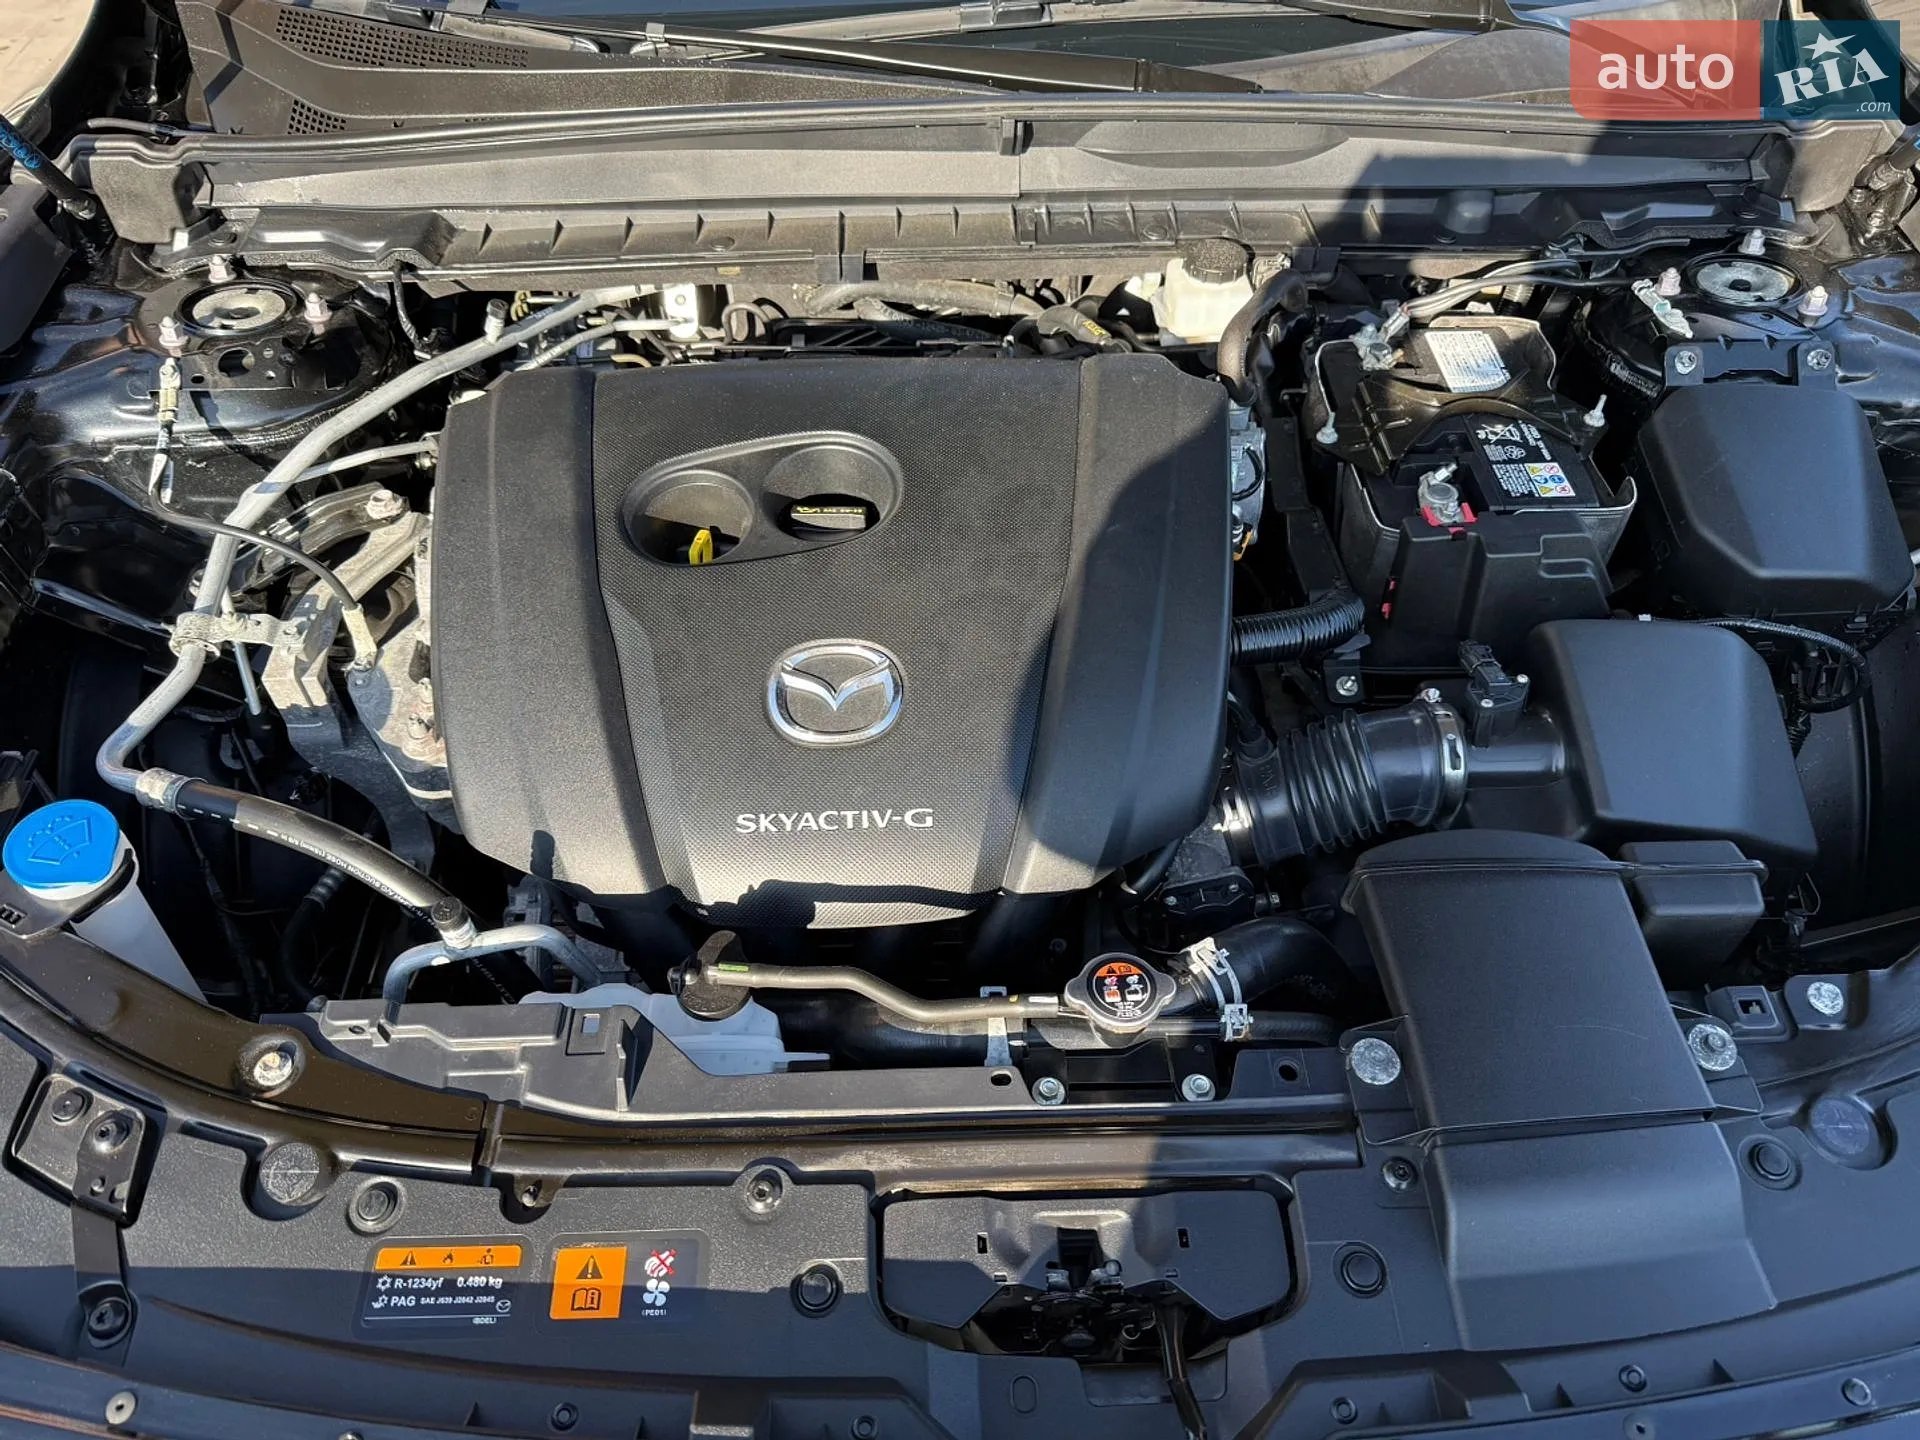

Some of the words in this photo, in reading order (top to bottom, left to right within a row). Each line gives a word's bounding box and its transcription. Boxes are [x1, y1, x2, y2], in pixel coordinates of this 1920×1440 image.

[736, 808, 934, 833] SKYACTIV-G
[325, 852, 347, 869] HOSE
[347, 863, 381, 888] SUCTION
[394, 1277, 444, 1290] R-1234yf
[456, 1276, 487, 1288] 0.480
[488, 1276, 503, 1289] kg
[390, 1295, 416, 1307] PAG
